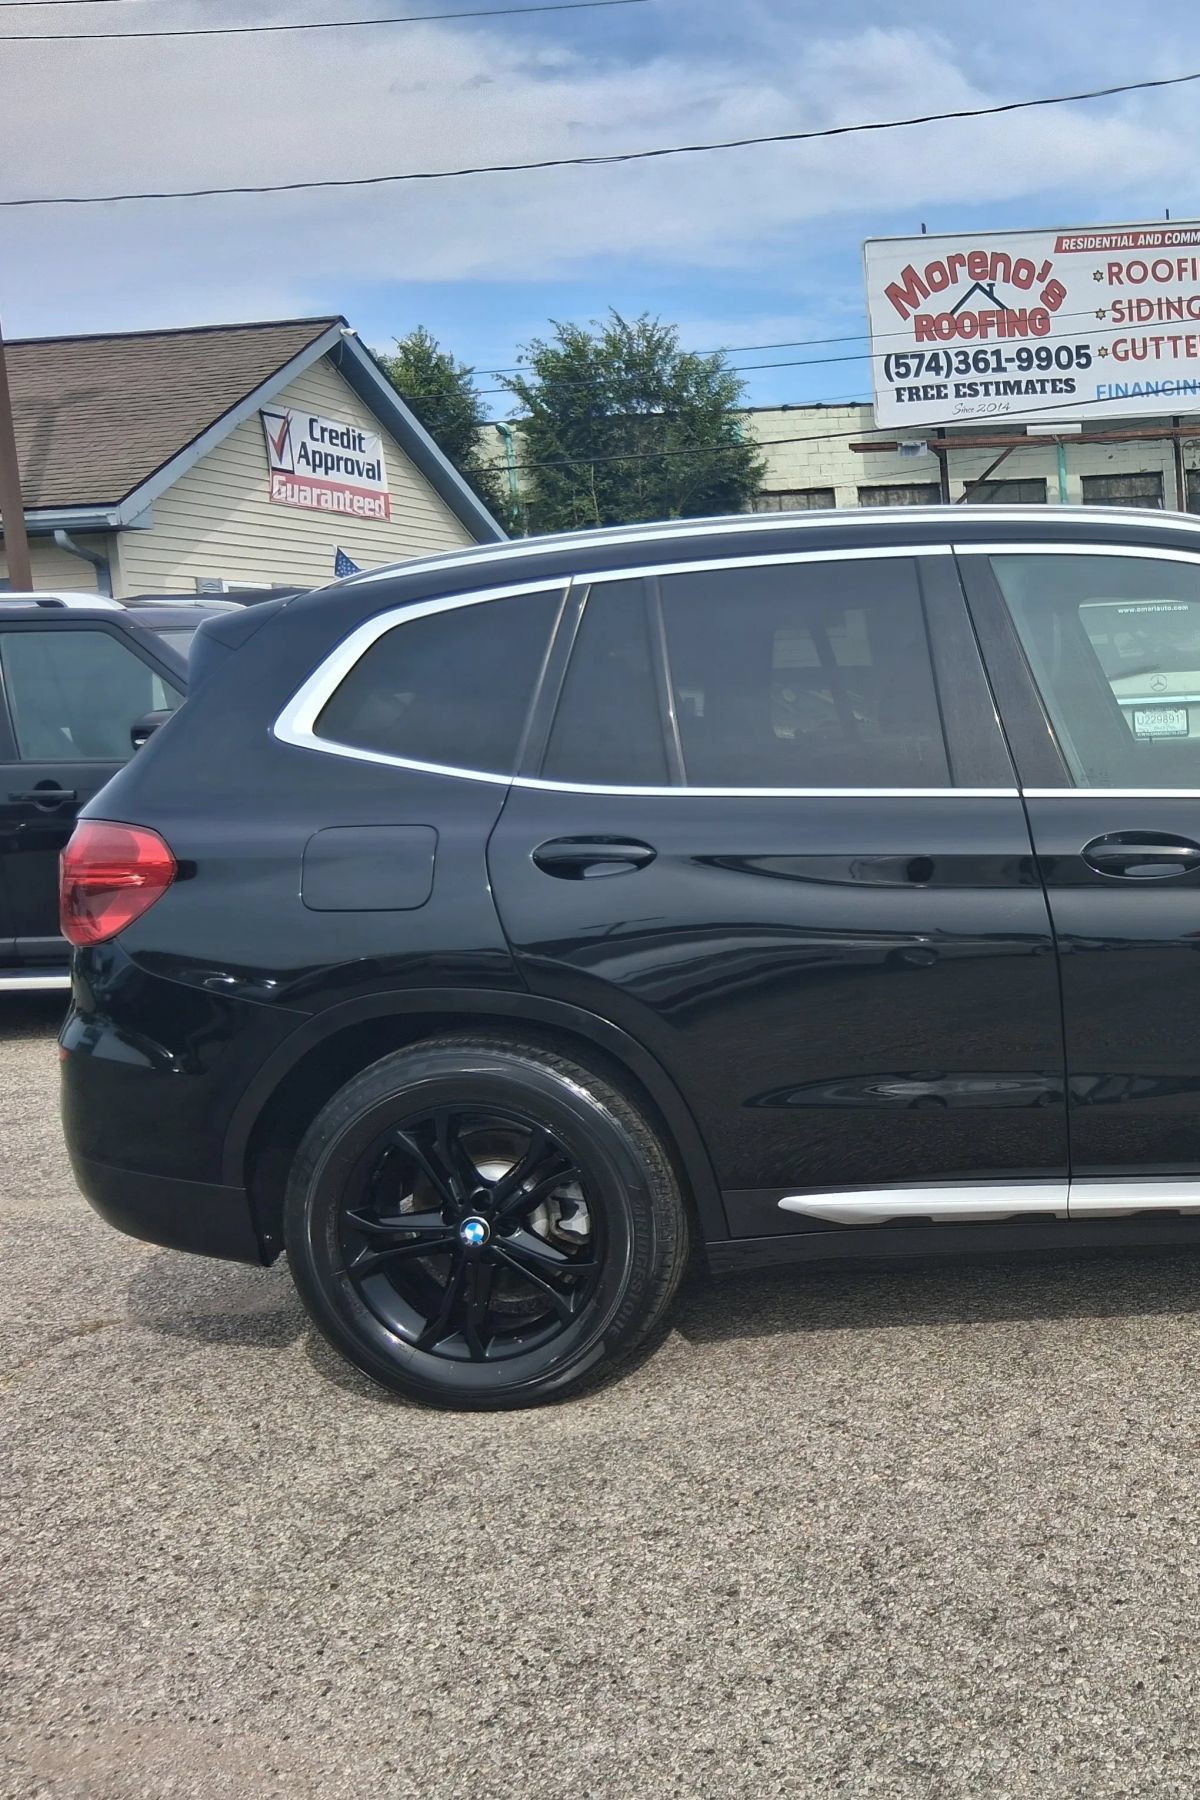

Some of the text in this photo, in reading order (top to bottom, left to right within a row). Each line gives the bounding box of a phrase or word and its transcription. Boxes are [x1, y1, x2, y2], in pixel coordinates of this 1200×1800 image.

[1062, 235, 1134, 250] RESIDENTIAL
[1137, 233, 1162, 246] AND
[884, 250, 1068, 321] Moreno's
[913, 307, 1051, 343] ROOFING
[883, 344, 1093, 382] (574)361-9905
[895, 378, 1077, 403] FREE ESTIMATES
[976, 402, 1012, 413] 2014
[308, 417, 366, 453] Credit
[297, 441, 382, 481] Approval
[271, 474, 386, 517] Guaranteed
